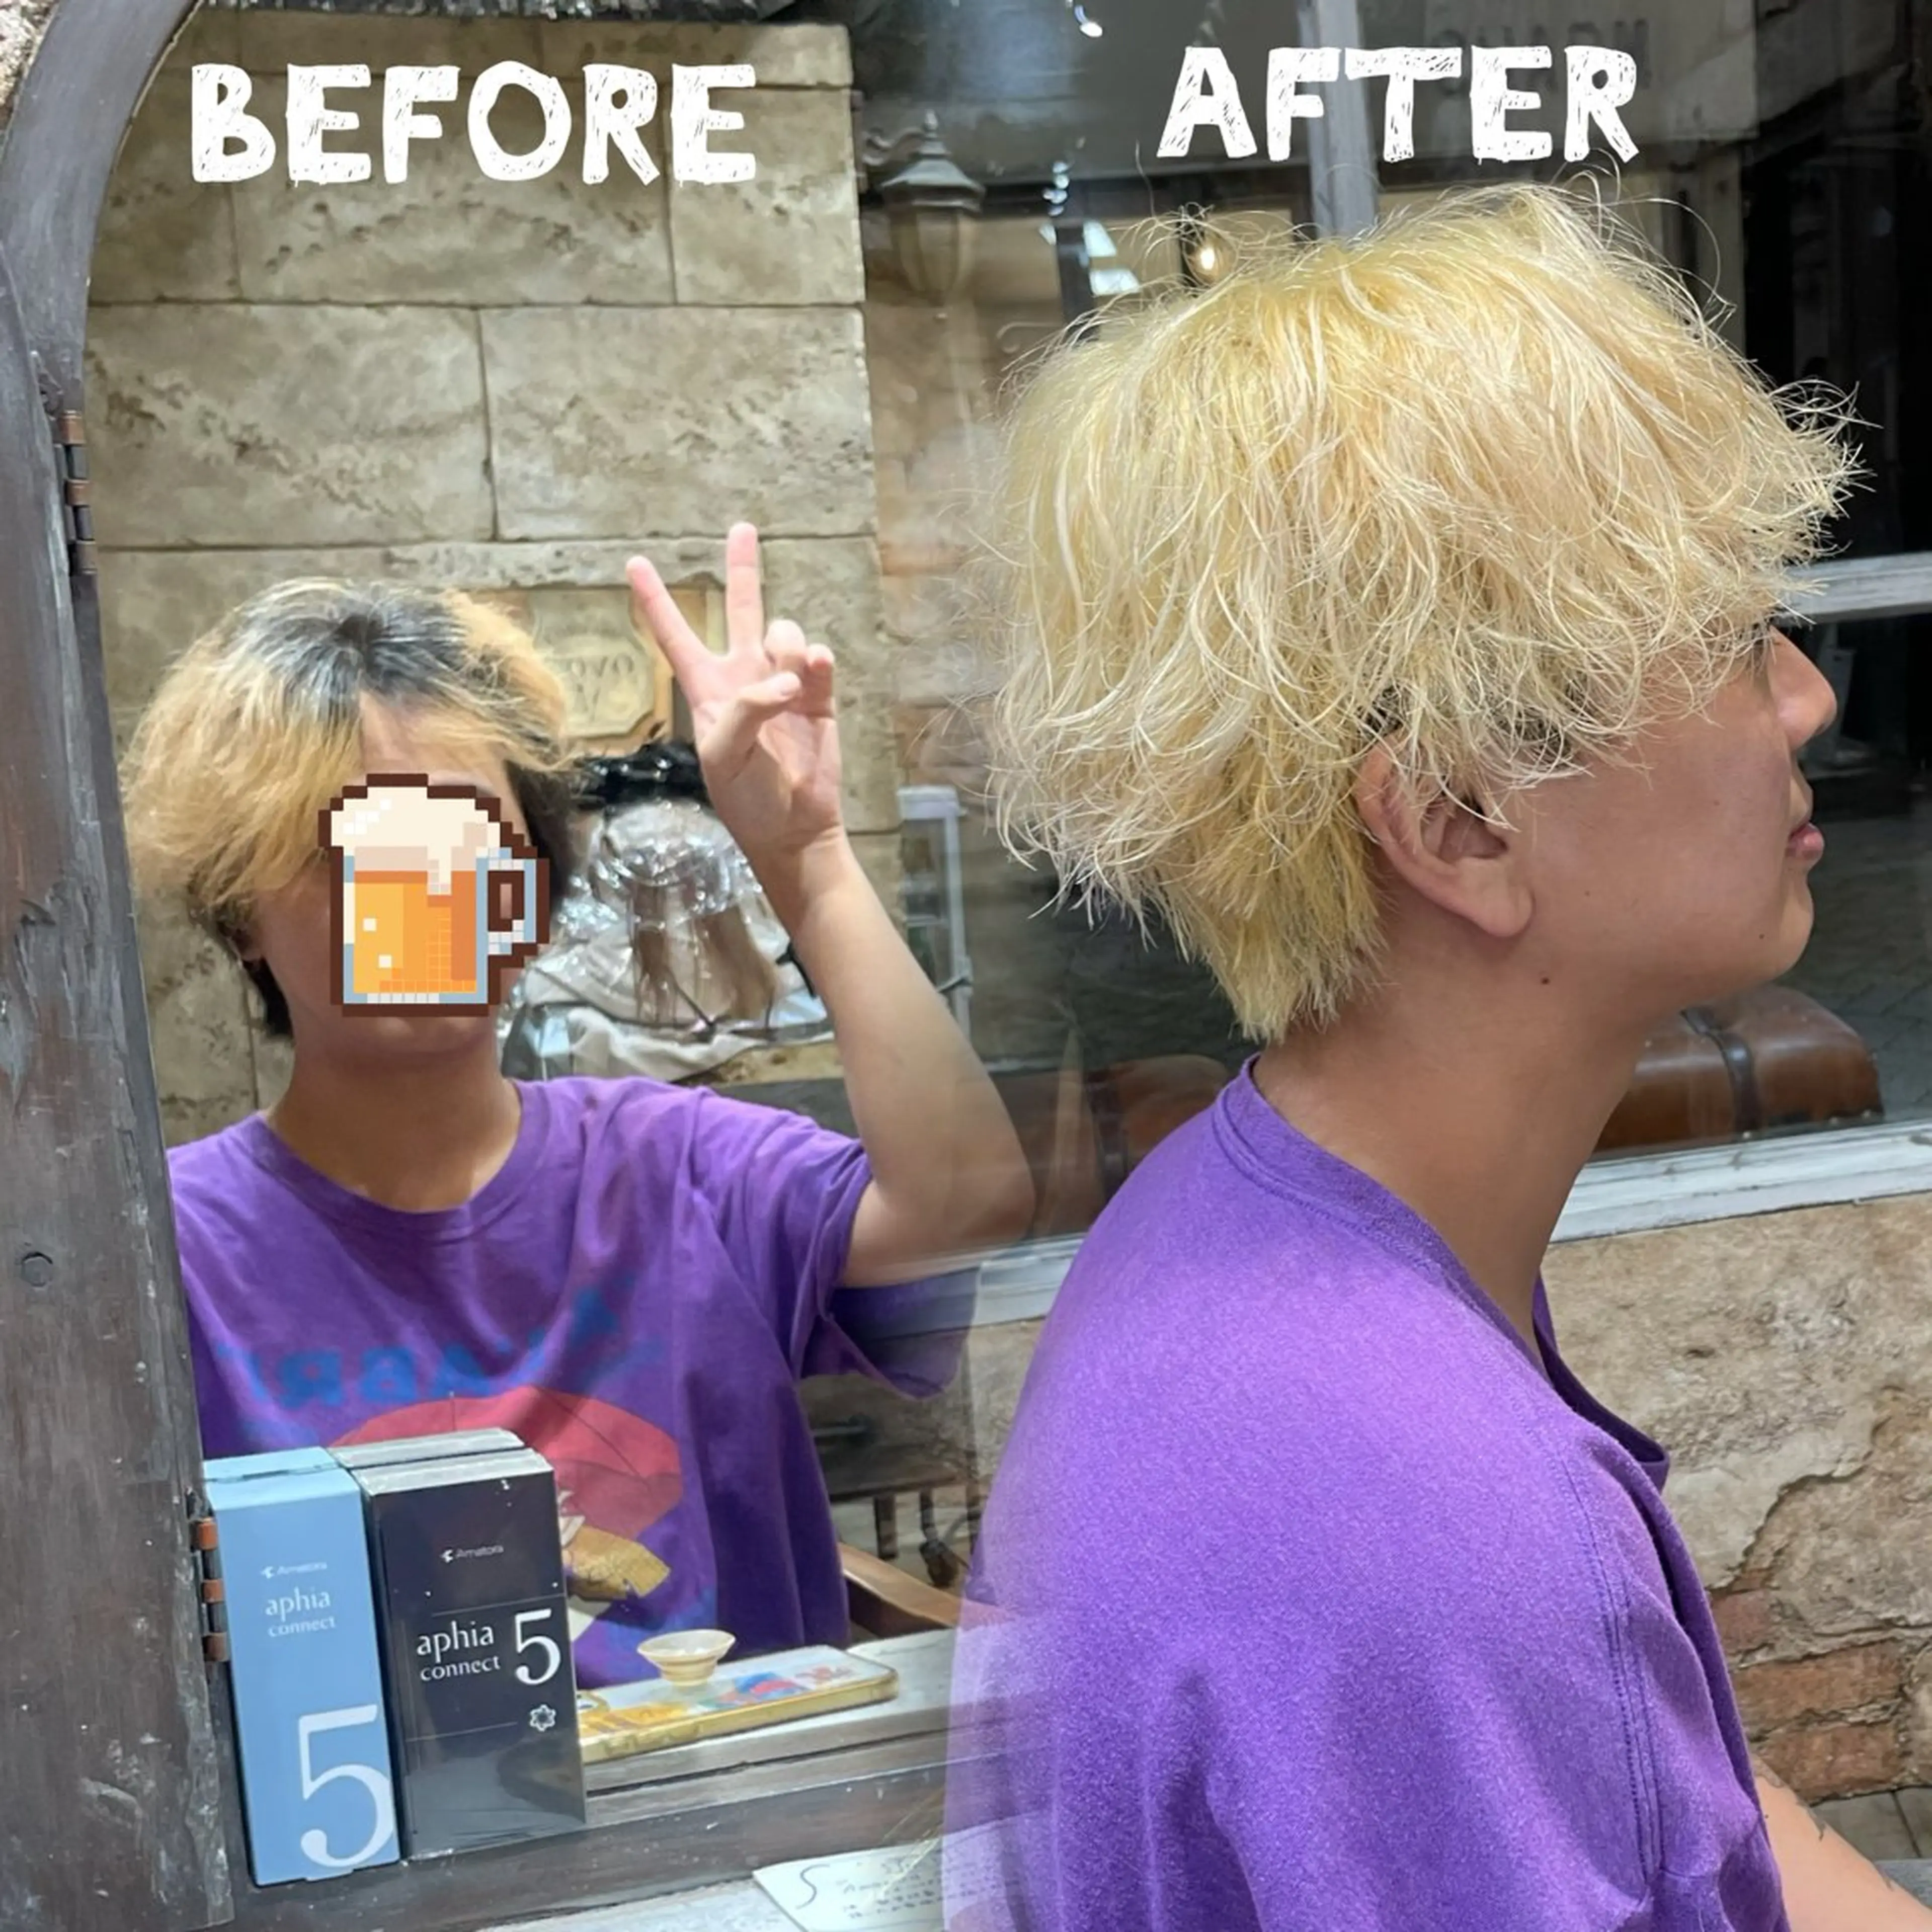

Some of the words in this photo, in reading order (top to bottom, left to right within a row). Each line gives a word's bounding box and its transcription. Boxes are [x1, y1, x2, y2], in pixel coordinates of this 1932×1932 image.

[265, 1586, 331, 1623] aphia
[268, 1616, 336, 1638] connect
[416, 1620, 495, 1663] aphia
[514, 1608, 561, 1685] 5
[420, 1655, 501, 1681] connect
[298, 1704, 394, 1868] 5
